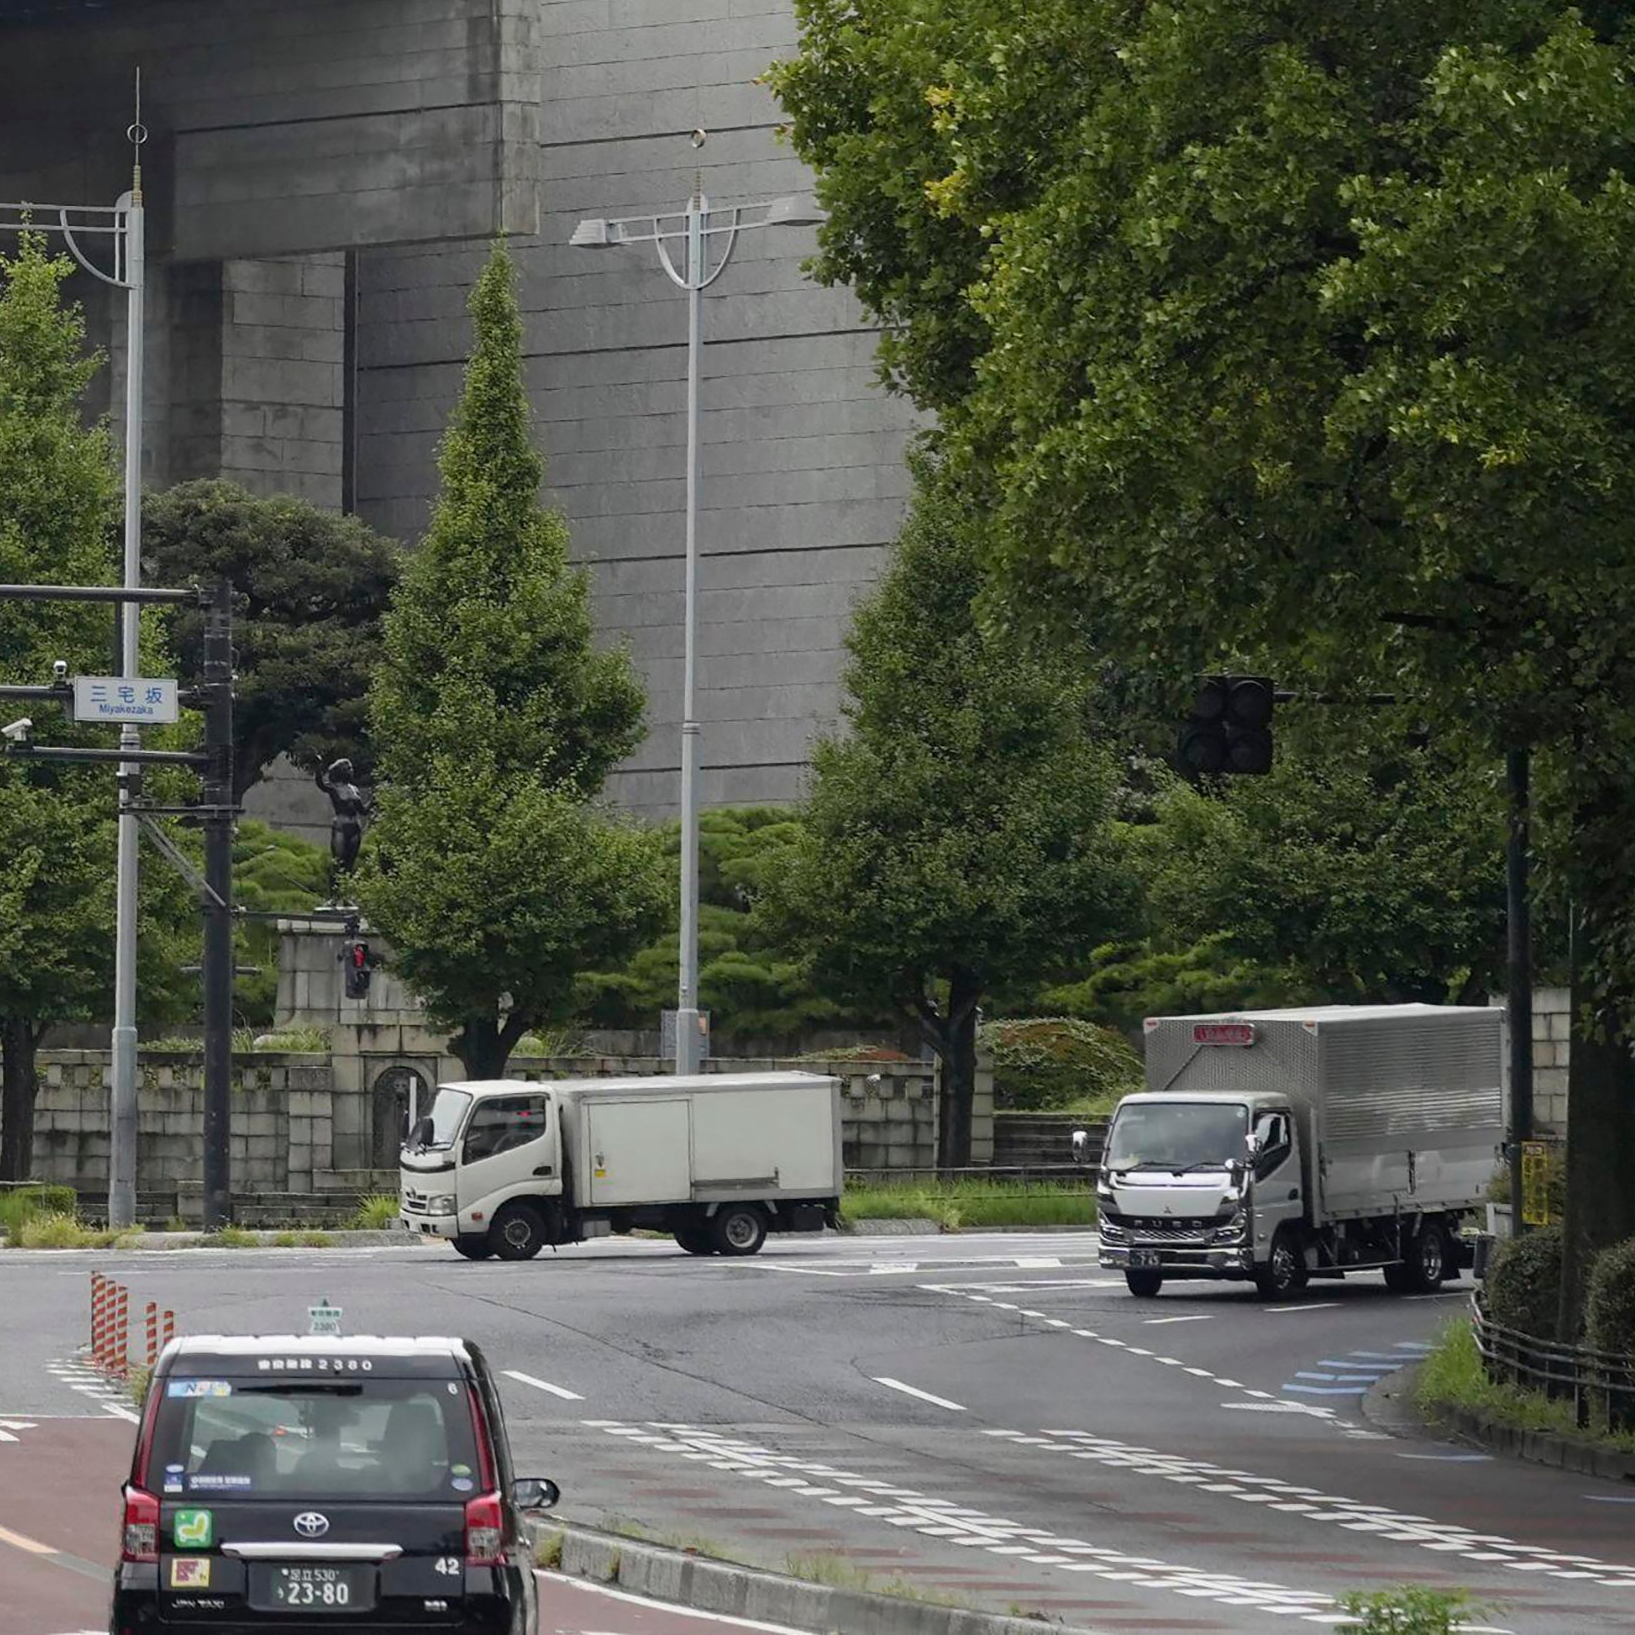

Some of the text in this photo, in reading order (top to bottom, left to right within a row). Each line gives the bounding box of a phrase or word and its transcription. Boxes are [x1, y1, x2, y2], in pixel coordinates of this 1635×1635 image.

[90, 685, 163, 704] 三宅坂
[99, 704, 153, 715] Miyakezaka
[318, 1358, 372, 1371] 2380
[435, 1557, 460, 1575] 42
[287, 1582, 349, 1605] 23-80
